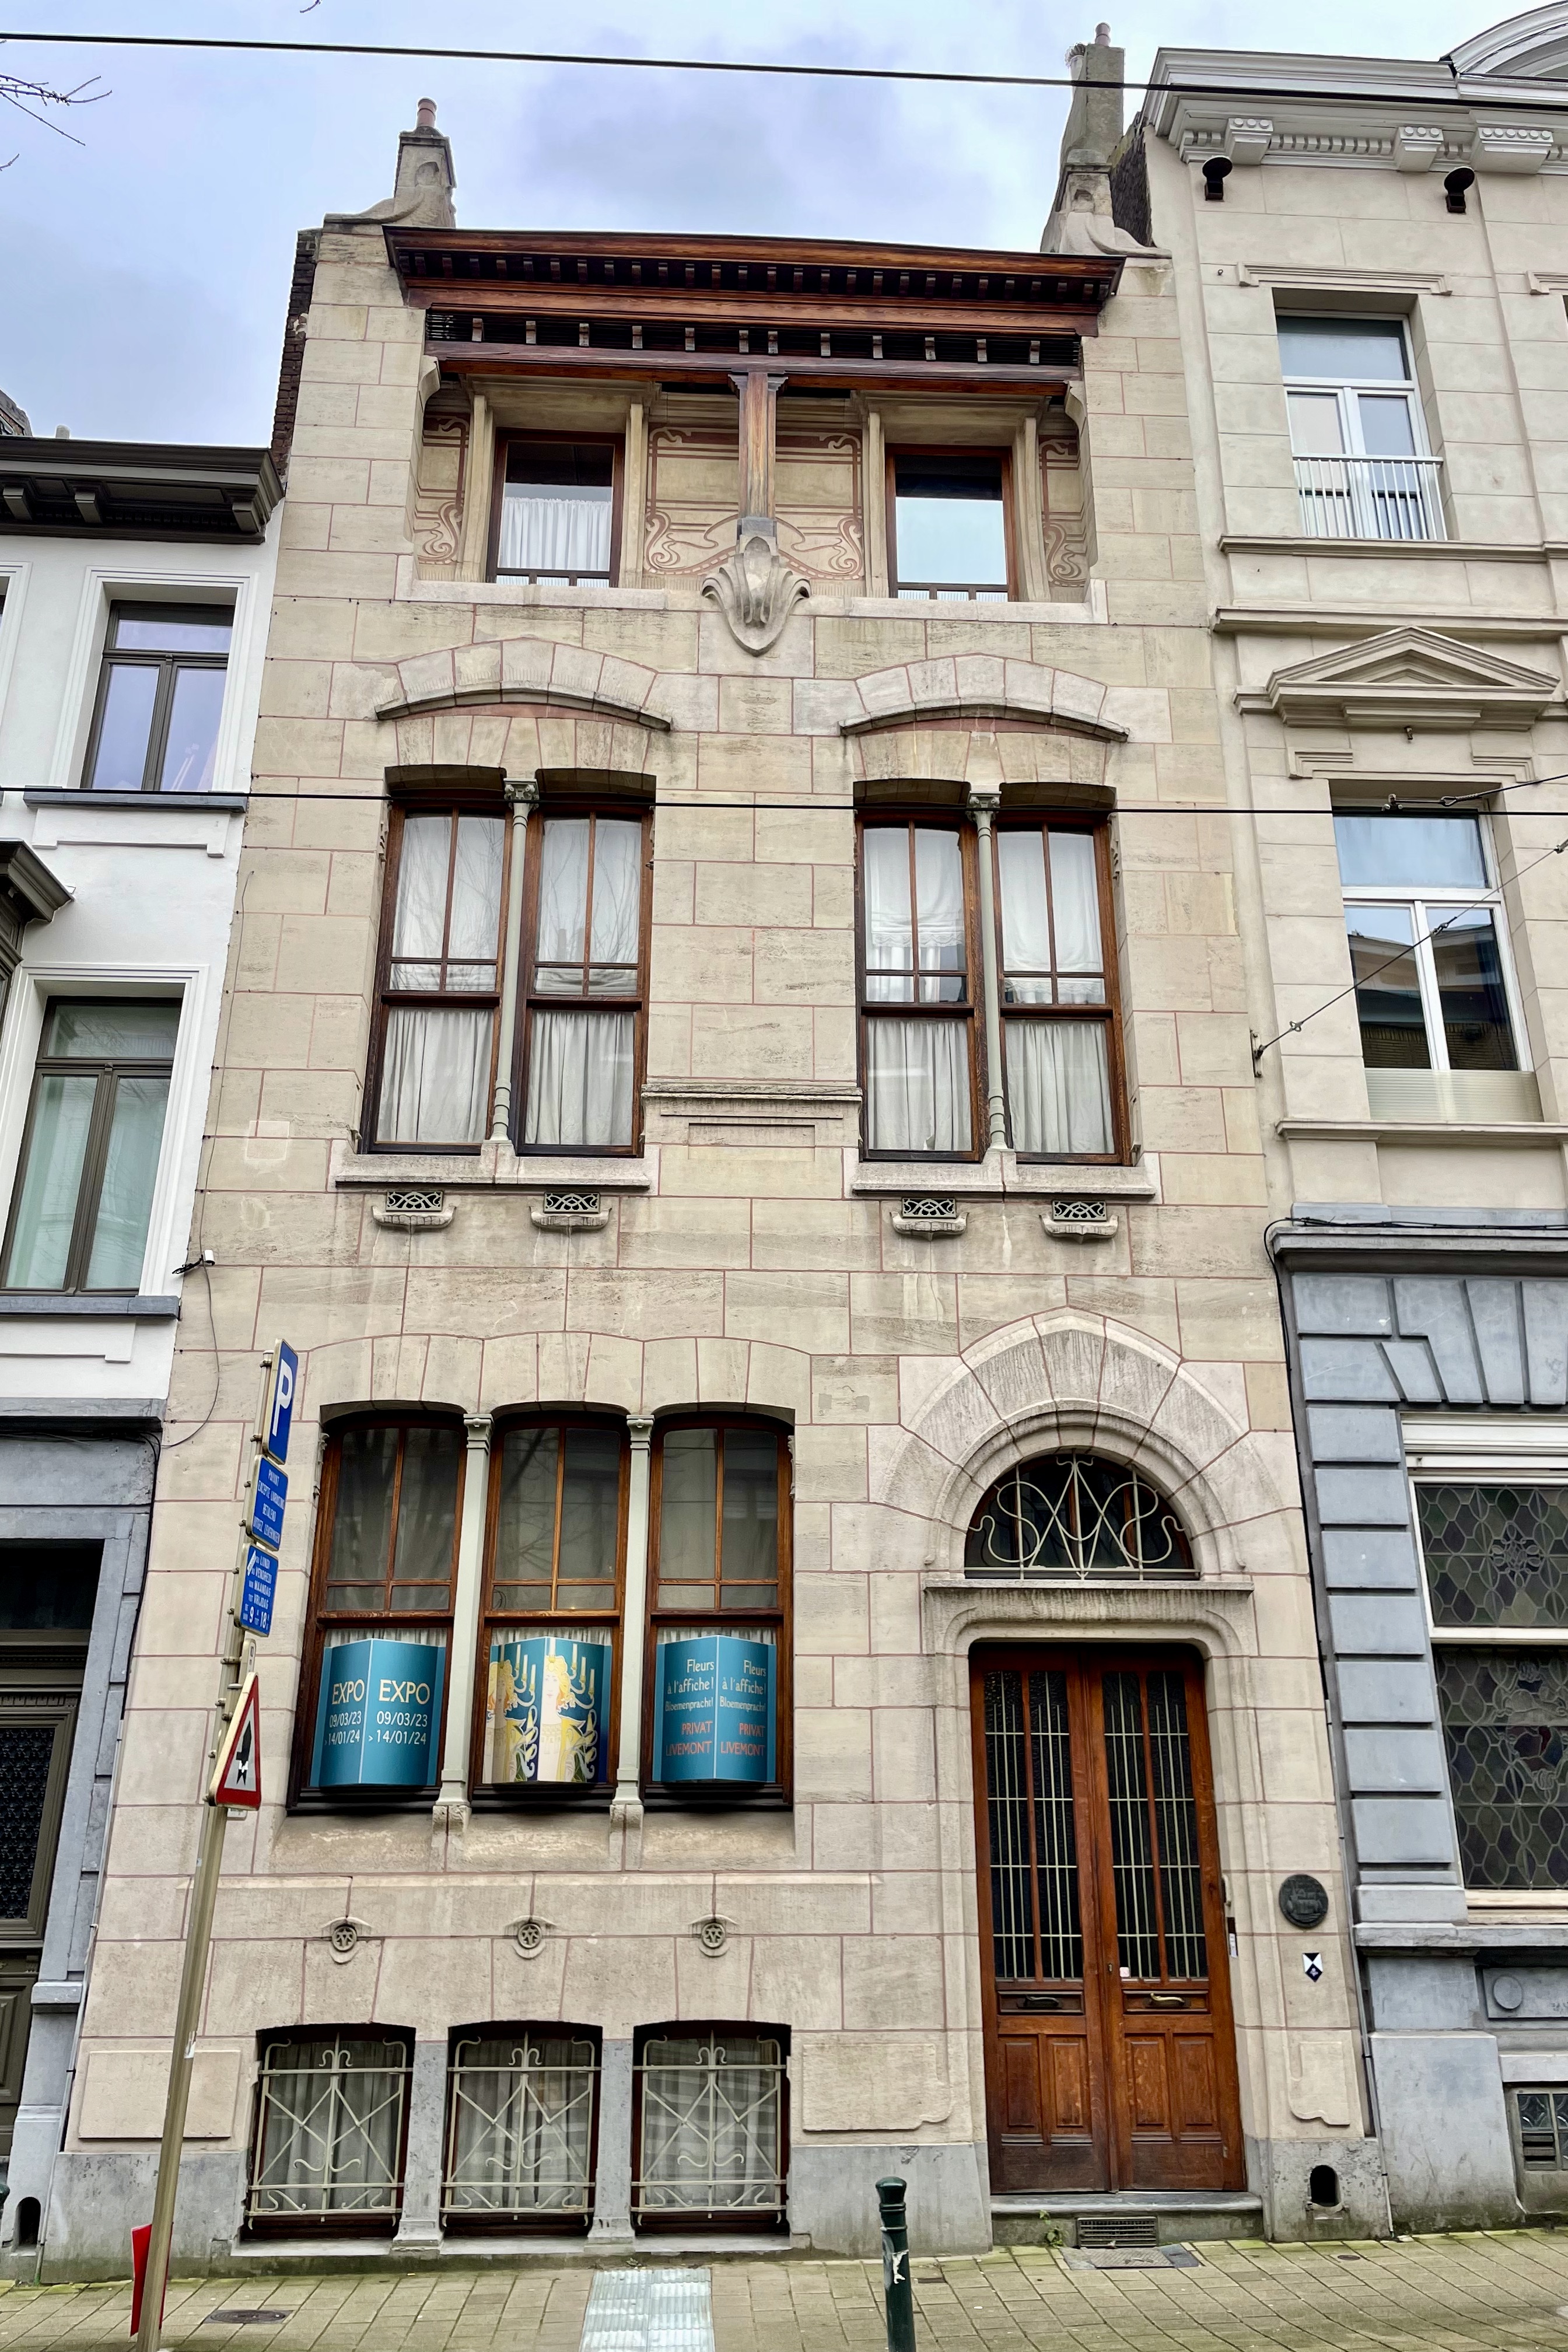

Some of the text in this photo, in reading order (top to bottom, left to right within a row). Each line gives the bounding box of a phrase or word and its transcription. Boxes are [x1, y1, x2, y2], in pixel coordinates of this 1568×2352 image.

[272, 1359, 293, 1437] P
[249, 1606, 254, 1623] 9
[260, 1611, 267, 1629] 18
[687, 1658, 714, 1673] Fleurs
[743, 1660, 766, 1676] Fleurs
[722, 1676, 728, 1690] à
[331, 1679, 365, 1704] EXPO
[379, 1679, 430, 1704] EXPO
[330, 1710, 362, 1727] 09/03/23
[376, 1711, 428, 1727] 09/03/23
[681, 1720, 713, 1735] PRIVAT
[739, 1723, 766, 1737] PRIVAT
[328, 1729, 360, 1745] 14/01/24
[376, 1730, 426, 1745] 14/01/24
[666, 1740, 713, 1756] LIVEMONT
[720, 1741, 765, 1756] LIVEMONT
